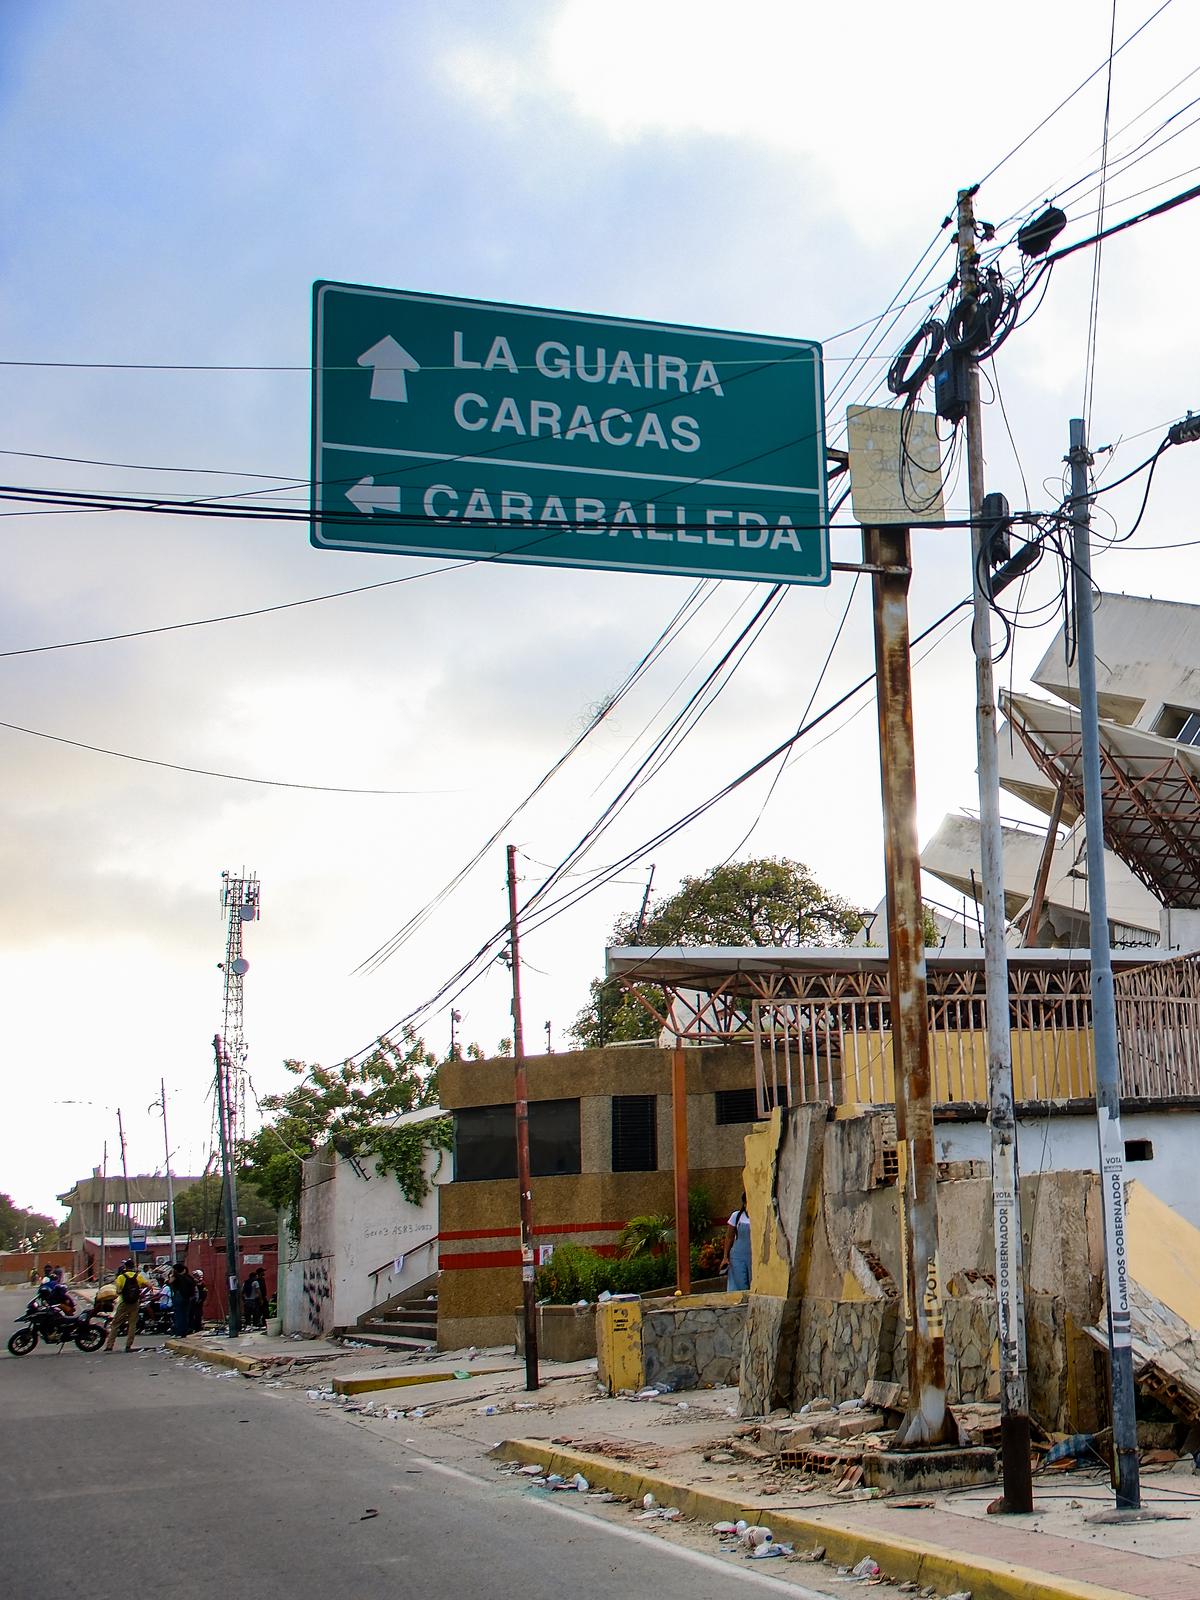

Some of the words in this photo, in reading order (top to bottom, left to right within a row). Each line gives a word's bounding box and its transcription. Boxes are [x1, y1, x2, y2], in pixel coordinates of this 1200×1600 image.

[453, 331, 518, 374] LA
[535, 341, 725, 397] GUAIRA
[453, 392, 701, 453] CARACAS
[423, 484, 803, 552] CARABALLEDA
[995, 1191, 1011, 1199] VOTA
[1112, 1174, 1125, 1257] GOBERNADOR
[1000, 1208, 1009, 1288] GOBERNADOR
[1117, 1259, 1128, 1311] CAMPOS
